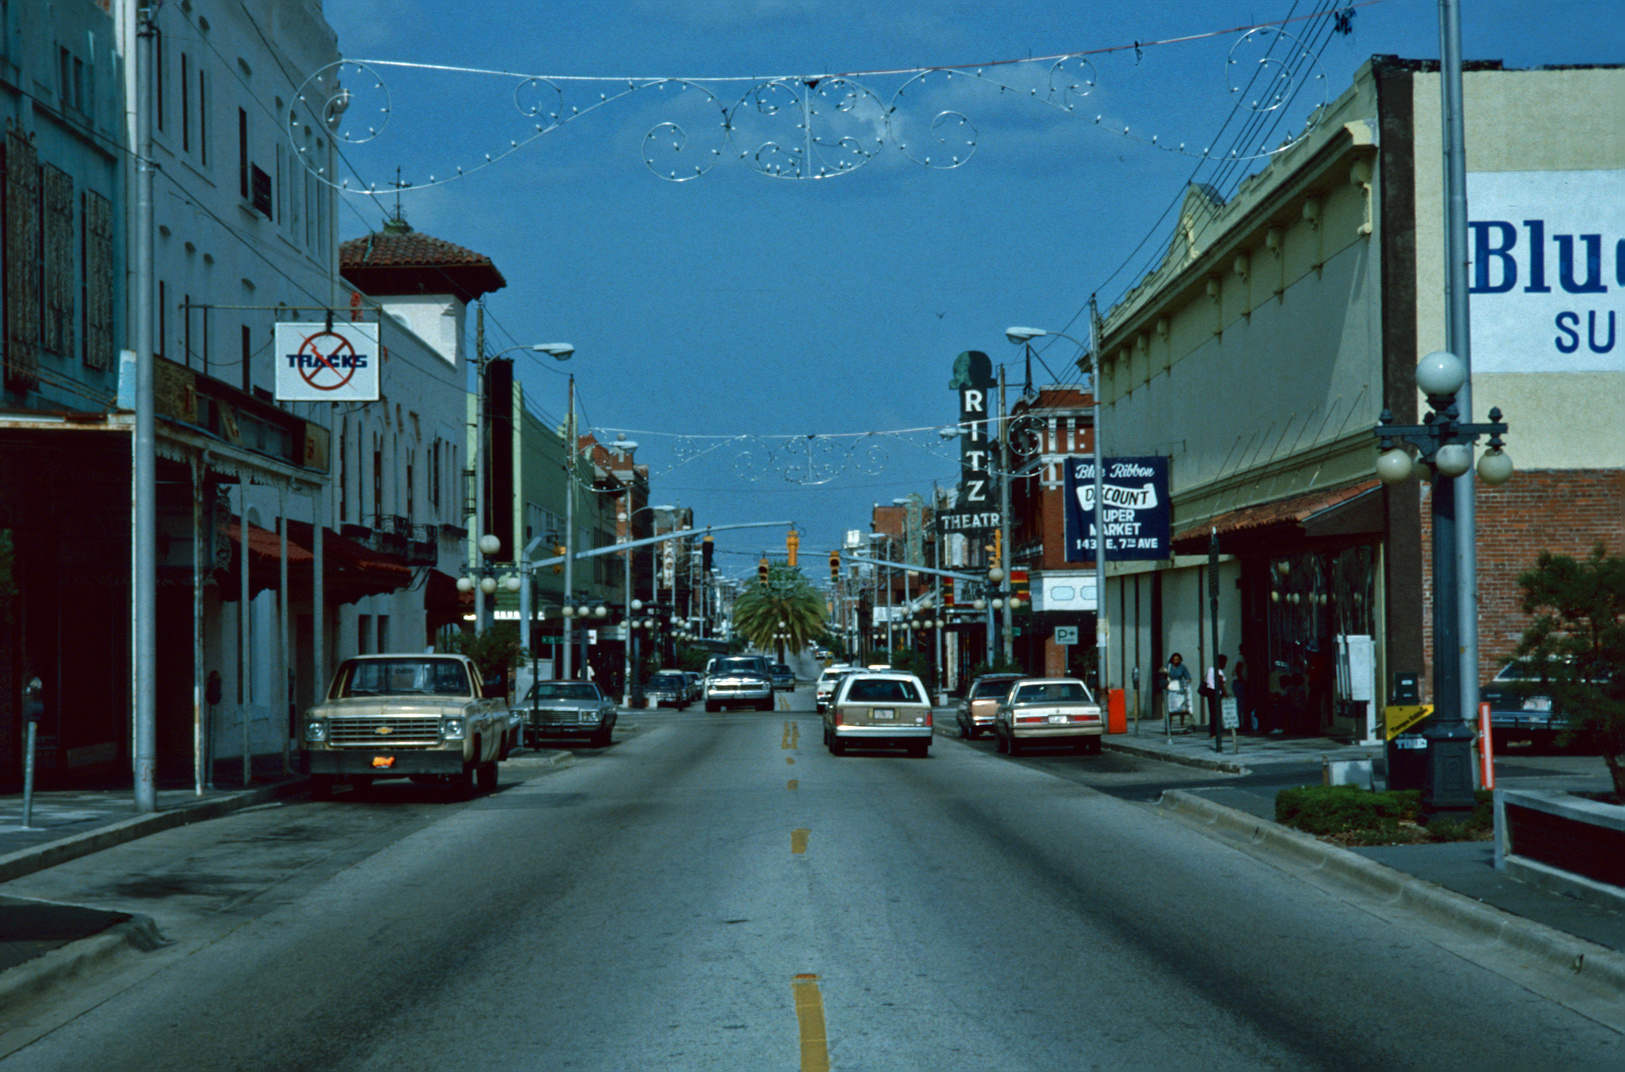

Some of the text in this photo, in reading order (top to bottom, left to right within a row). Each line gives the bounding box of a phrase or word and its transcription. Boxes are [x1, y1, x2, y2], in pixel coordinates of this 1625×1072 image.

[1468, 219, 1625, 294] Blu
[1555, 309, 1616, 354] SU
[286, 354, 367, 368] TRACKS
[964, 389, 986, 502] RITZ
[1109, 462, 1155, 478] Ribbon
[1085, 487, 1150, 506] DCOUNT
[941, 512, 1004, 529] THEATR
[1102, 509, 1135, 522] UPER
[1105, 538, 1117, 549] E.
[1137, 538, 1158, 549] AVE
[1058, 629, 1068, 641] P
